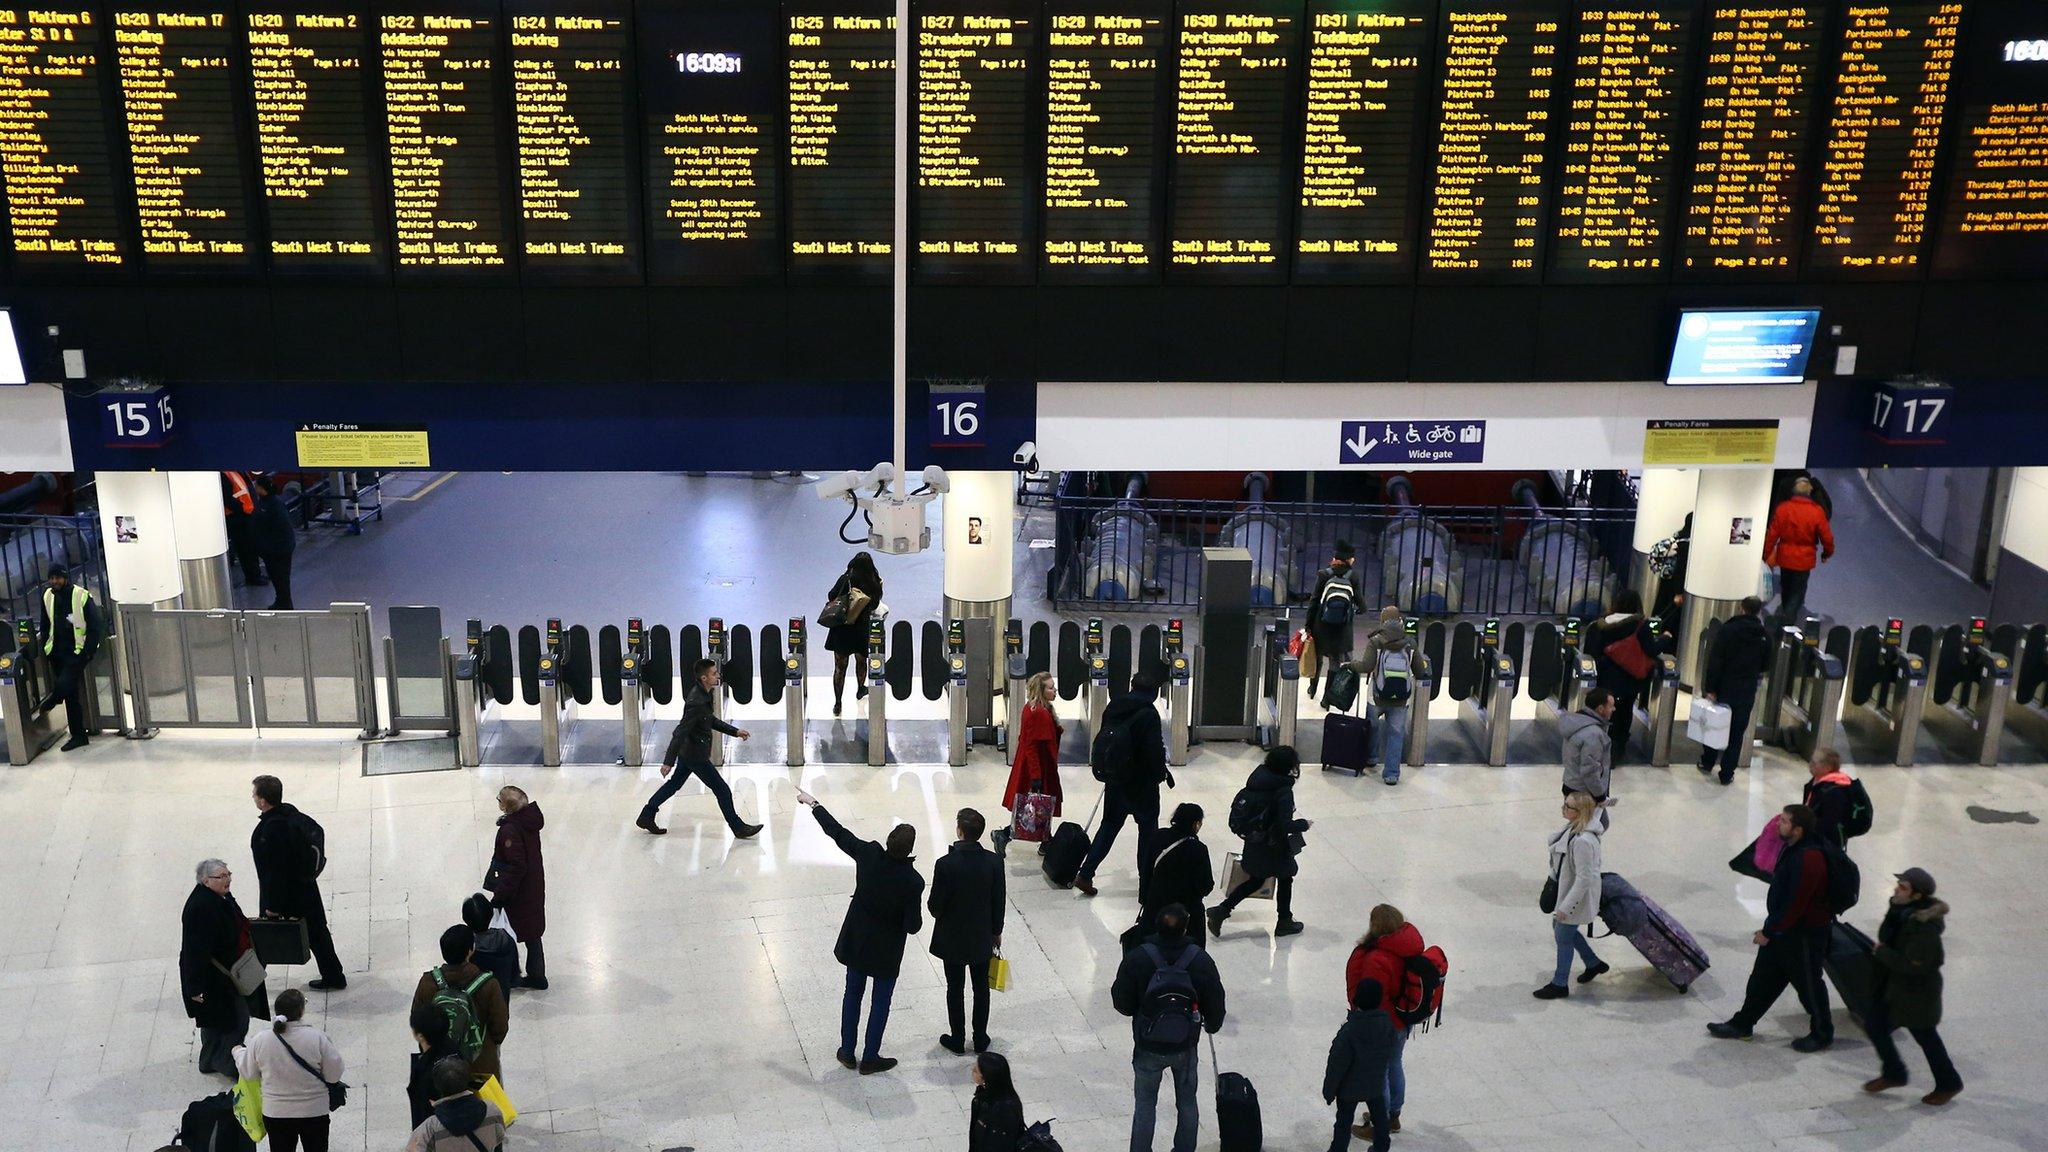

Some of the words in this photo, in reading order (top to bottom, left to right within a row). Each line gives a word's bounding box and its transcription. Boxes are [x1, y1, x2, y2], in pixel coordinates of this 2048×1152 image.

[29, 11, 78, 24] Platform
[81, 12, 91, 24] 6
[1849, 7, 1889, 17] Weymouth
[115, 13, 150, 25] 16:20
[157, 14, 207, 26] Platform
[211, 14, 224, 26] 17
[249, 14, 282, 27] 16:20
[296, 15, 345, 27] Platform
[348, 15, 357, 27] 2
[381, 16, 415, 28] 16:22
[424, 16, 472, 28] Platform
[513, 17, 546, 29] 16:24
[555, 17, 602, 29] Platform
[791, 17, 823, 29] 16:25
[834, 17, 881, 29] Platform
[922, 16, 954, 28] 16:27
[963, 16, 1011, 29] Platform
[1095, 16, 1142, 29] Platform
[1226, 15, 1274, 27] Platform
[1357, 14, 1405, 27] Platform
[1450, 13, 1507, 23] Basingstoke
[31, 27, 46, 41] St
[50, 28, 60, 41] D
[64, 28, 73, 41] &
[115, 30, 164, 45] Reading
[248, 31, 289, 45] Woking
[380, 33, 448, 45] Addlestone
[789, 34, 821, 45] Alton
[1051, 33, 1096, 45] Windsor
[1101, 33, 1110, 45] &
[1114, 33, 1143, 45] Eton
[1181, 32, 1252, 44] Portsmouth
[1256, 31, 1279, 44] Hbr
[1313, 31, 1380, 46] Teddington
[512, 33, 559, 47] Dorking
[919, 33, 991, 47] Strawberry
[1447, 35, 1508, 45] Farnborough
[1446, 57, 1492, 66] Guildford
[122, 79, 166, 88] Richmond
[1838, 75, 1886, 84] Basingstoke
[675, 114, 698, 122] South
[700, 114, 719, 122] West
[722, 114, 747, 122] Trains
[665, 125, 703, 133] Christmas
[706, 125, 726, 133] train
[728, 125, 757, 133] service
[1440, 122, 1492, 131] Portsmouth
[1495, 122, 1533, 130] Harbour
[130, 134, 171, 144] Virginia
[174, 134, 200, 142] Water
[1828, 140, 1865, 149] Salisbury
[0, 143, 48, 153] Salisbury
[664, 147, 700, 156] Saturday
[702, 146, 720, 154] 27th
[723, 146, 759, 154] December
[1439, 144, 1480, 153] Richmond
[683, 157, 712, 165] revised
[715, 157, 750, 166] Saturday
[721, 168, 752, 177] operate
[1437, 165, 1493, 174] Southampton
[1496, 165, 1532, 173] Central
[671, 178, 687, 186] with
[690, 178, 733, 188] engineering
[1435, 187, 1471, 195] Staines
[671, 199, 697, 209] Sunday
[720, 199, 756, 207] December
[703, 210, 729, 219] Sunday
[1434, 208, 1474, 216] Surbiton
[697, 220, 727, 229] operate
[682, 231, 725, 240] engineering
[15, 239, 47, 250] South
[50, 240, 77, 251] West
[81, 240, 115, 251] Trains
[144, 241, 175, 252] South
[179, 241, 205, 253] West
[209, 241, 243, 252] Trains
[272, 241, 303, 252] South
[307, 241, 333, 253] West
[337, 242, 370, 253] Trains
[399, 242, 430, 253] South
[434, 242, 460, 253] West
[464, 242, 497, 254] Trains
[526, 242, 557, 253] South
[561, 243, 586, 253] West
[591, 242, 623, 253] Trains
[793, 242, 824, 253] South
[828, 242, 853, 253] West
[858, 242, 891, 253] Trains
[919, 241, 950, 253] South
[954, 242, 979, 253] West
[984, 242, 1017, 253] Trains
[1046, 241, 1076, 253] South
[1080, 241, 1106, 253] West
[1111, 241, 1143, 253] Trains
[1173, 241, 1203, 252] South
[1207, 241, 1233, 252] West
[1237, 240, 1270, 252] Trains
[1299, 240, 1330, 252] South
[1334, 240, 1359, 252] West
[1364, 240, 1397, 251] Trains
[84, 254, 122, 263] Trolley
[1429, 250, 1460, 259] Woking
[1588, 259, 1617, 269] Page
[1633, 259, 1647, 267] of
[1651, 259, 1660, 267] 2
[1715, 258, 1743, 267] Page
[1748, 257, 1757, 265] 2
[1761, 257, 1774, 265] of
[1779, 257, 1788, 265] 2
[1843, 256, 1872, 266] Page
[1877, 256, 1885, 264] 2
[1890, 255, 1904, 264] of
[1908, 255, 1917, 263] 2
[157, 395, 173, 433] 15
[1873, 393, 1893, 428] 17
[1903, 399, 1946, 433] 17
[107, 402, 150, 437] 15
[936, 401, 979, 436] 16
[313, 423, 337, 431] Penalty
[1664, 420, 1689, 429] Penalty
[1690, 420, 1709, 428] Fares
[1408, 449, 1431, 460] Wide
[1432, 451, 1454, 462] gate
